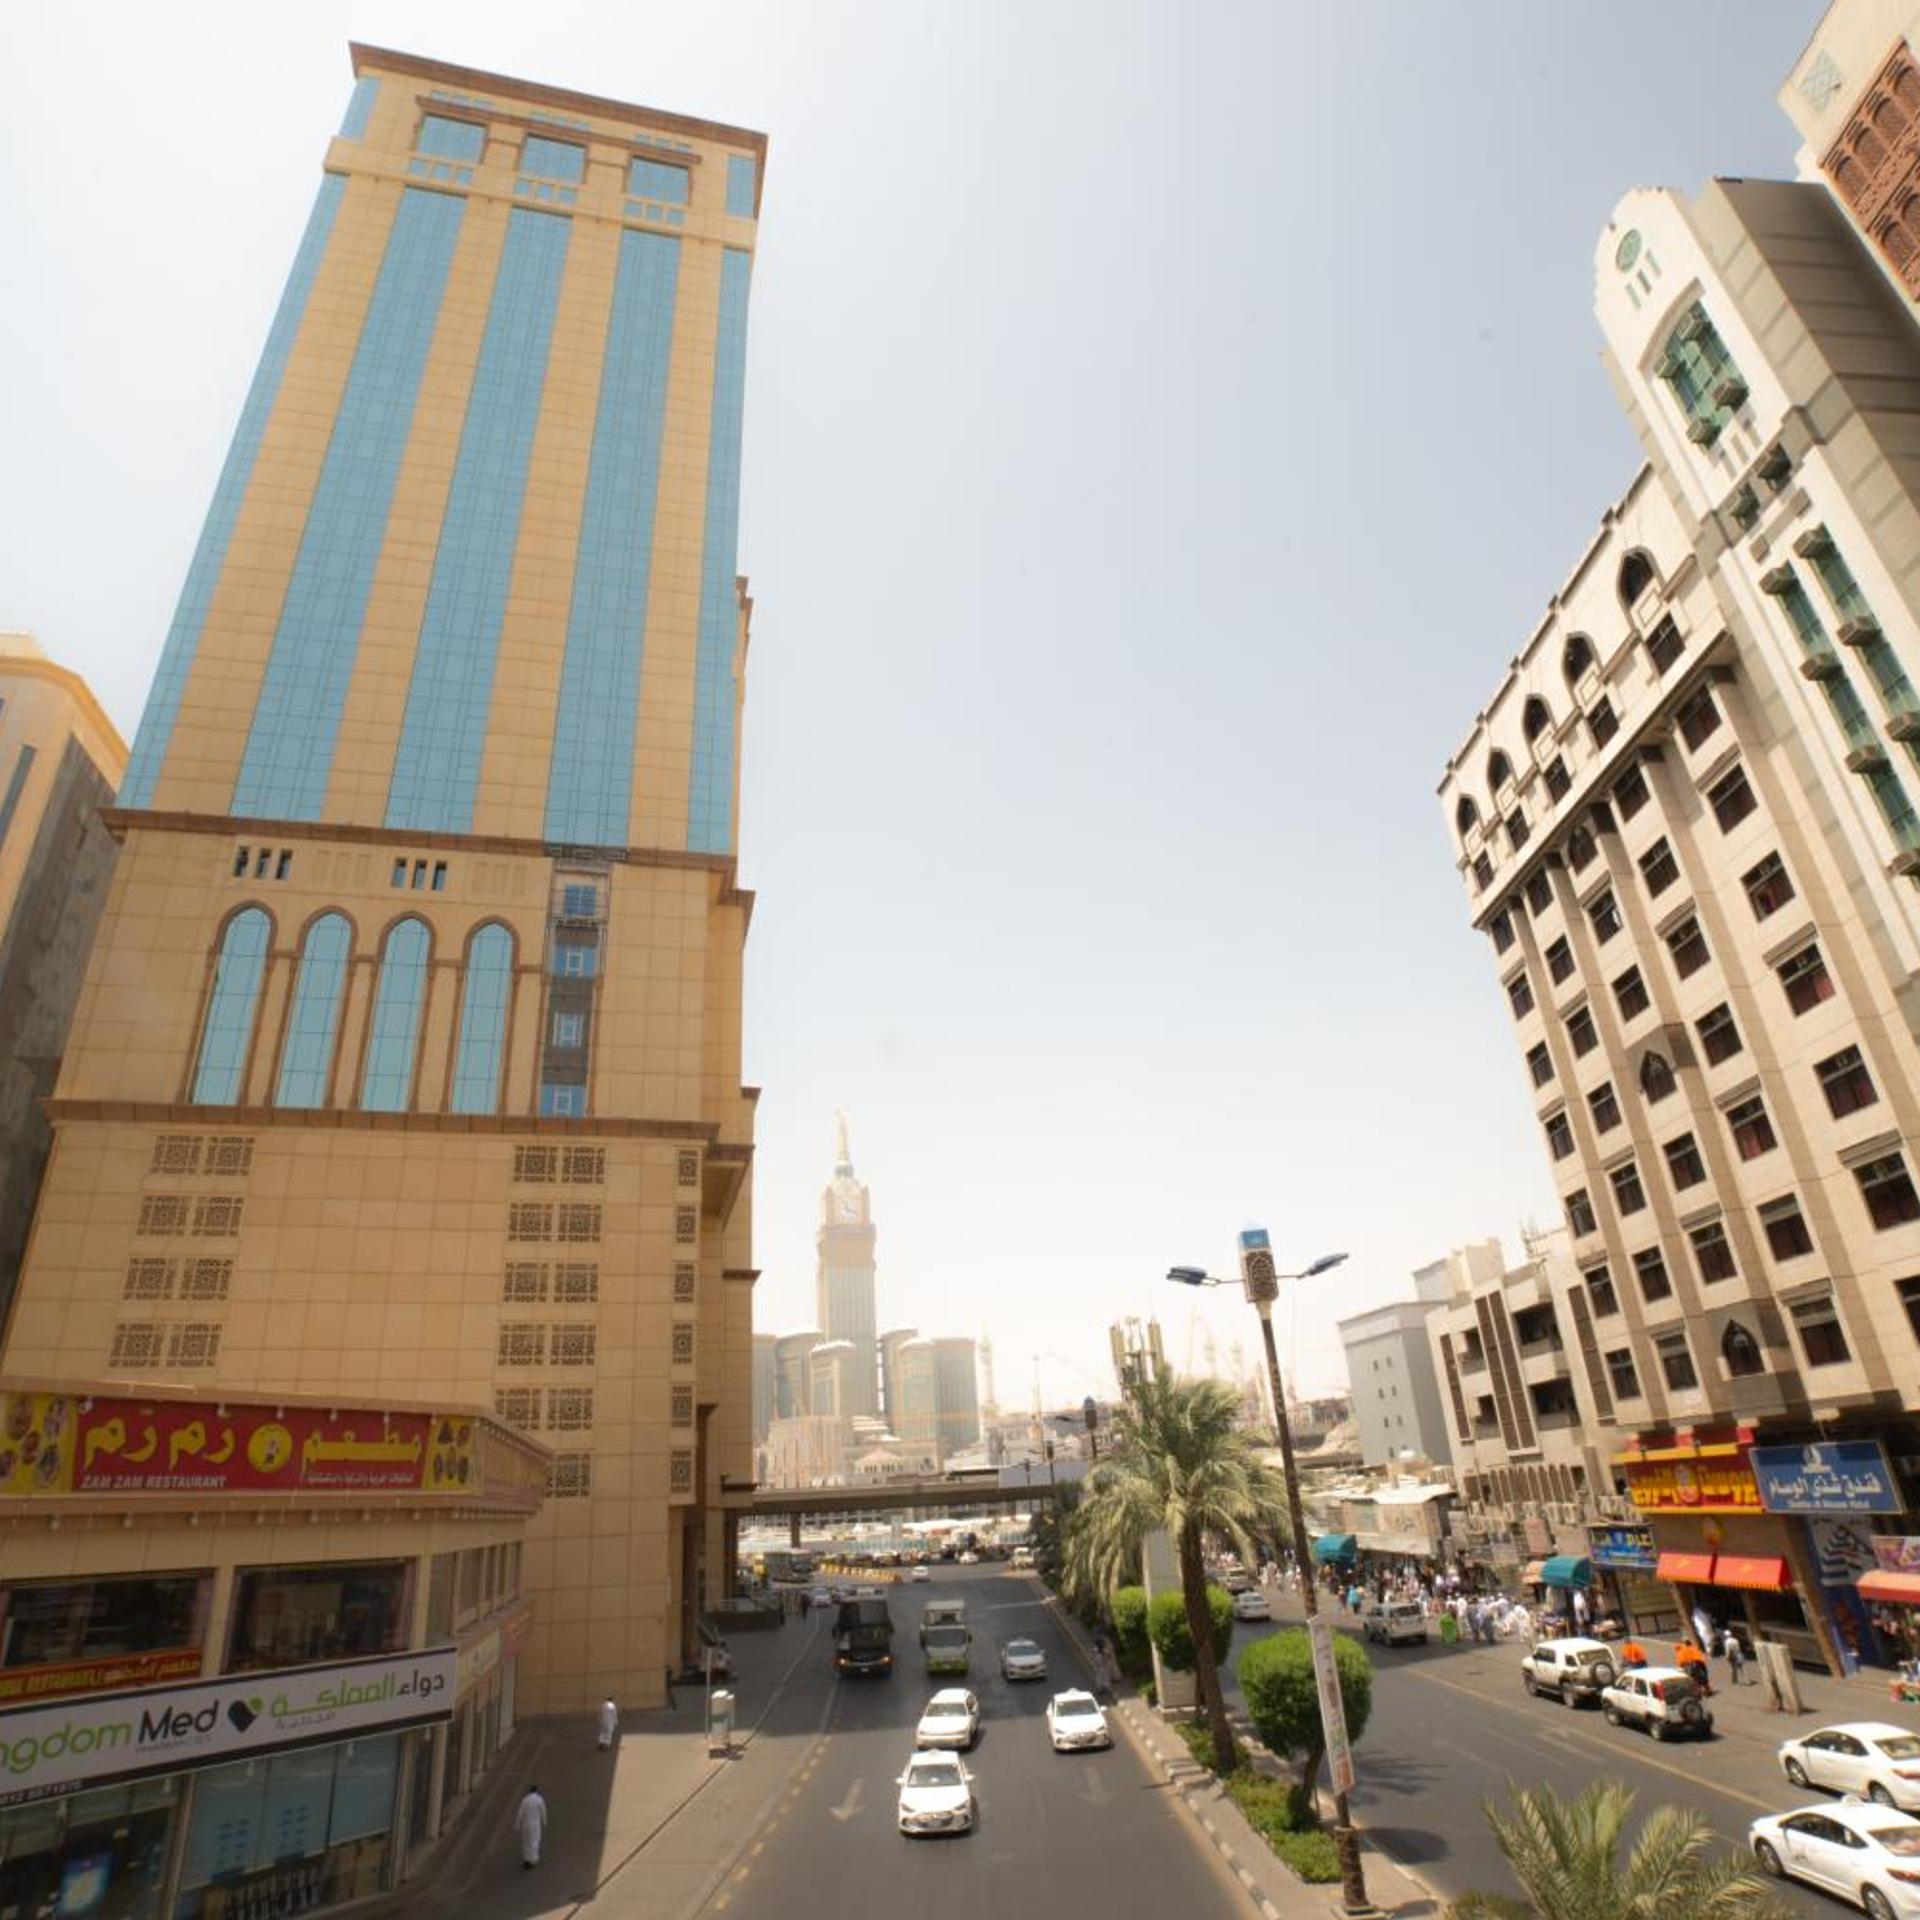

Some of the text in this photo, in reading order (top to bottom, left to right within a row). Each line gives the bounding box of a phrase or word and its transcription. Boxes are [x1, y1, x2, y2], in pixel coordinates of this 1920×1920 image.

[302, 1426, 421, 1475] مطعم
[81, 1475, 227, 1489] ZAM ZAM RESTAURANT
[271, 1670, 445, 1718] دواء المملكة
[137, 1700, 220, 1744] Med
